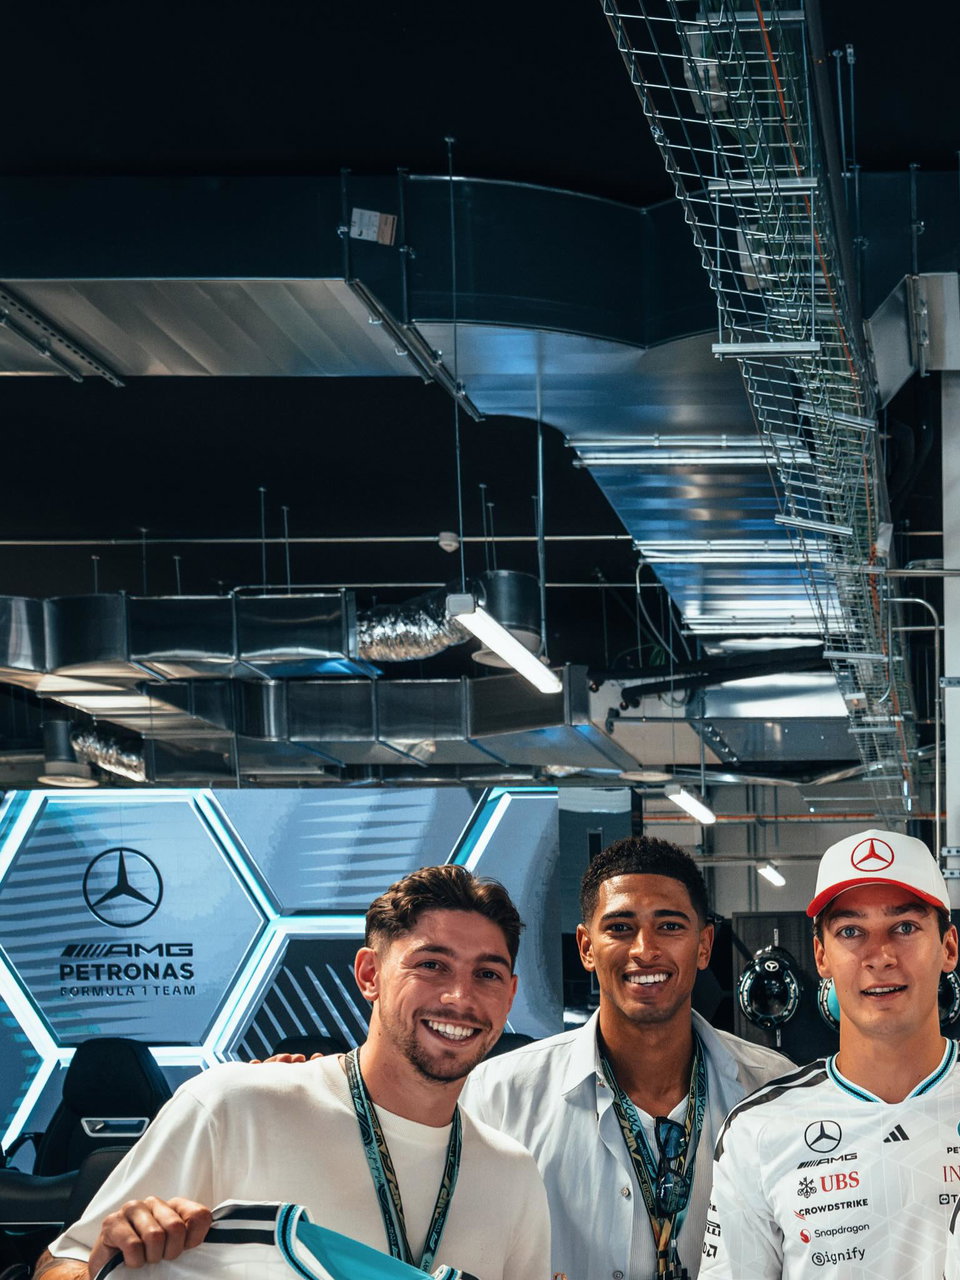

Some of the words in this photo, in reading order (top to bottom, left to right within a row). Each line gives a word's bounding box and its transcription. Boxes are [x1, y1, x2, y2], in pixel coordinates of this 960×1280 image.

[102, 943, 194, 957] AMG
[59, 963, 194, 981] PETRONAS
[60, 986, 135, 997] FORMULA
[141, 986, 147, 996] 1
[152, 985, 196, 996] TEAM
[818, 1152, 858, 1165] AMG
[820, 1171, 860, 1193] UBS
[799, 1199, 869, 1217] CROWDSTRIKE
[814, 1223, 870, 1239] Snapdragon
